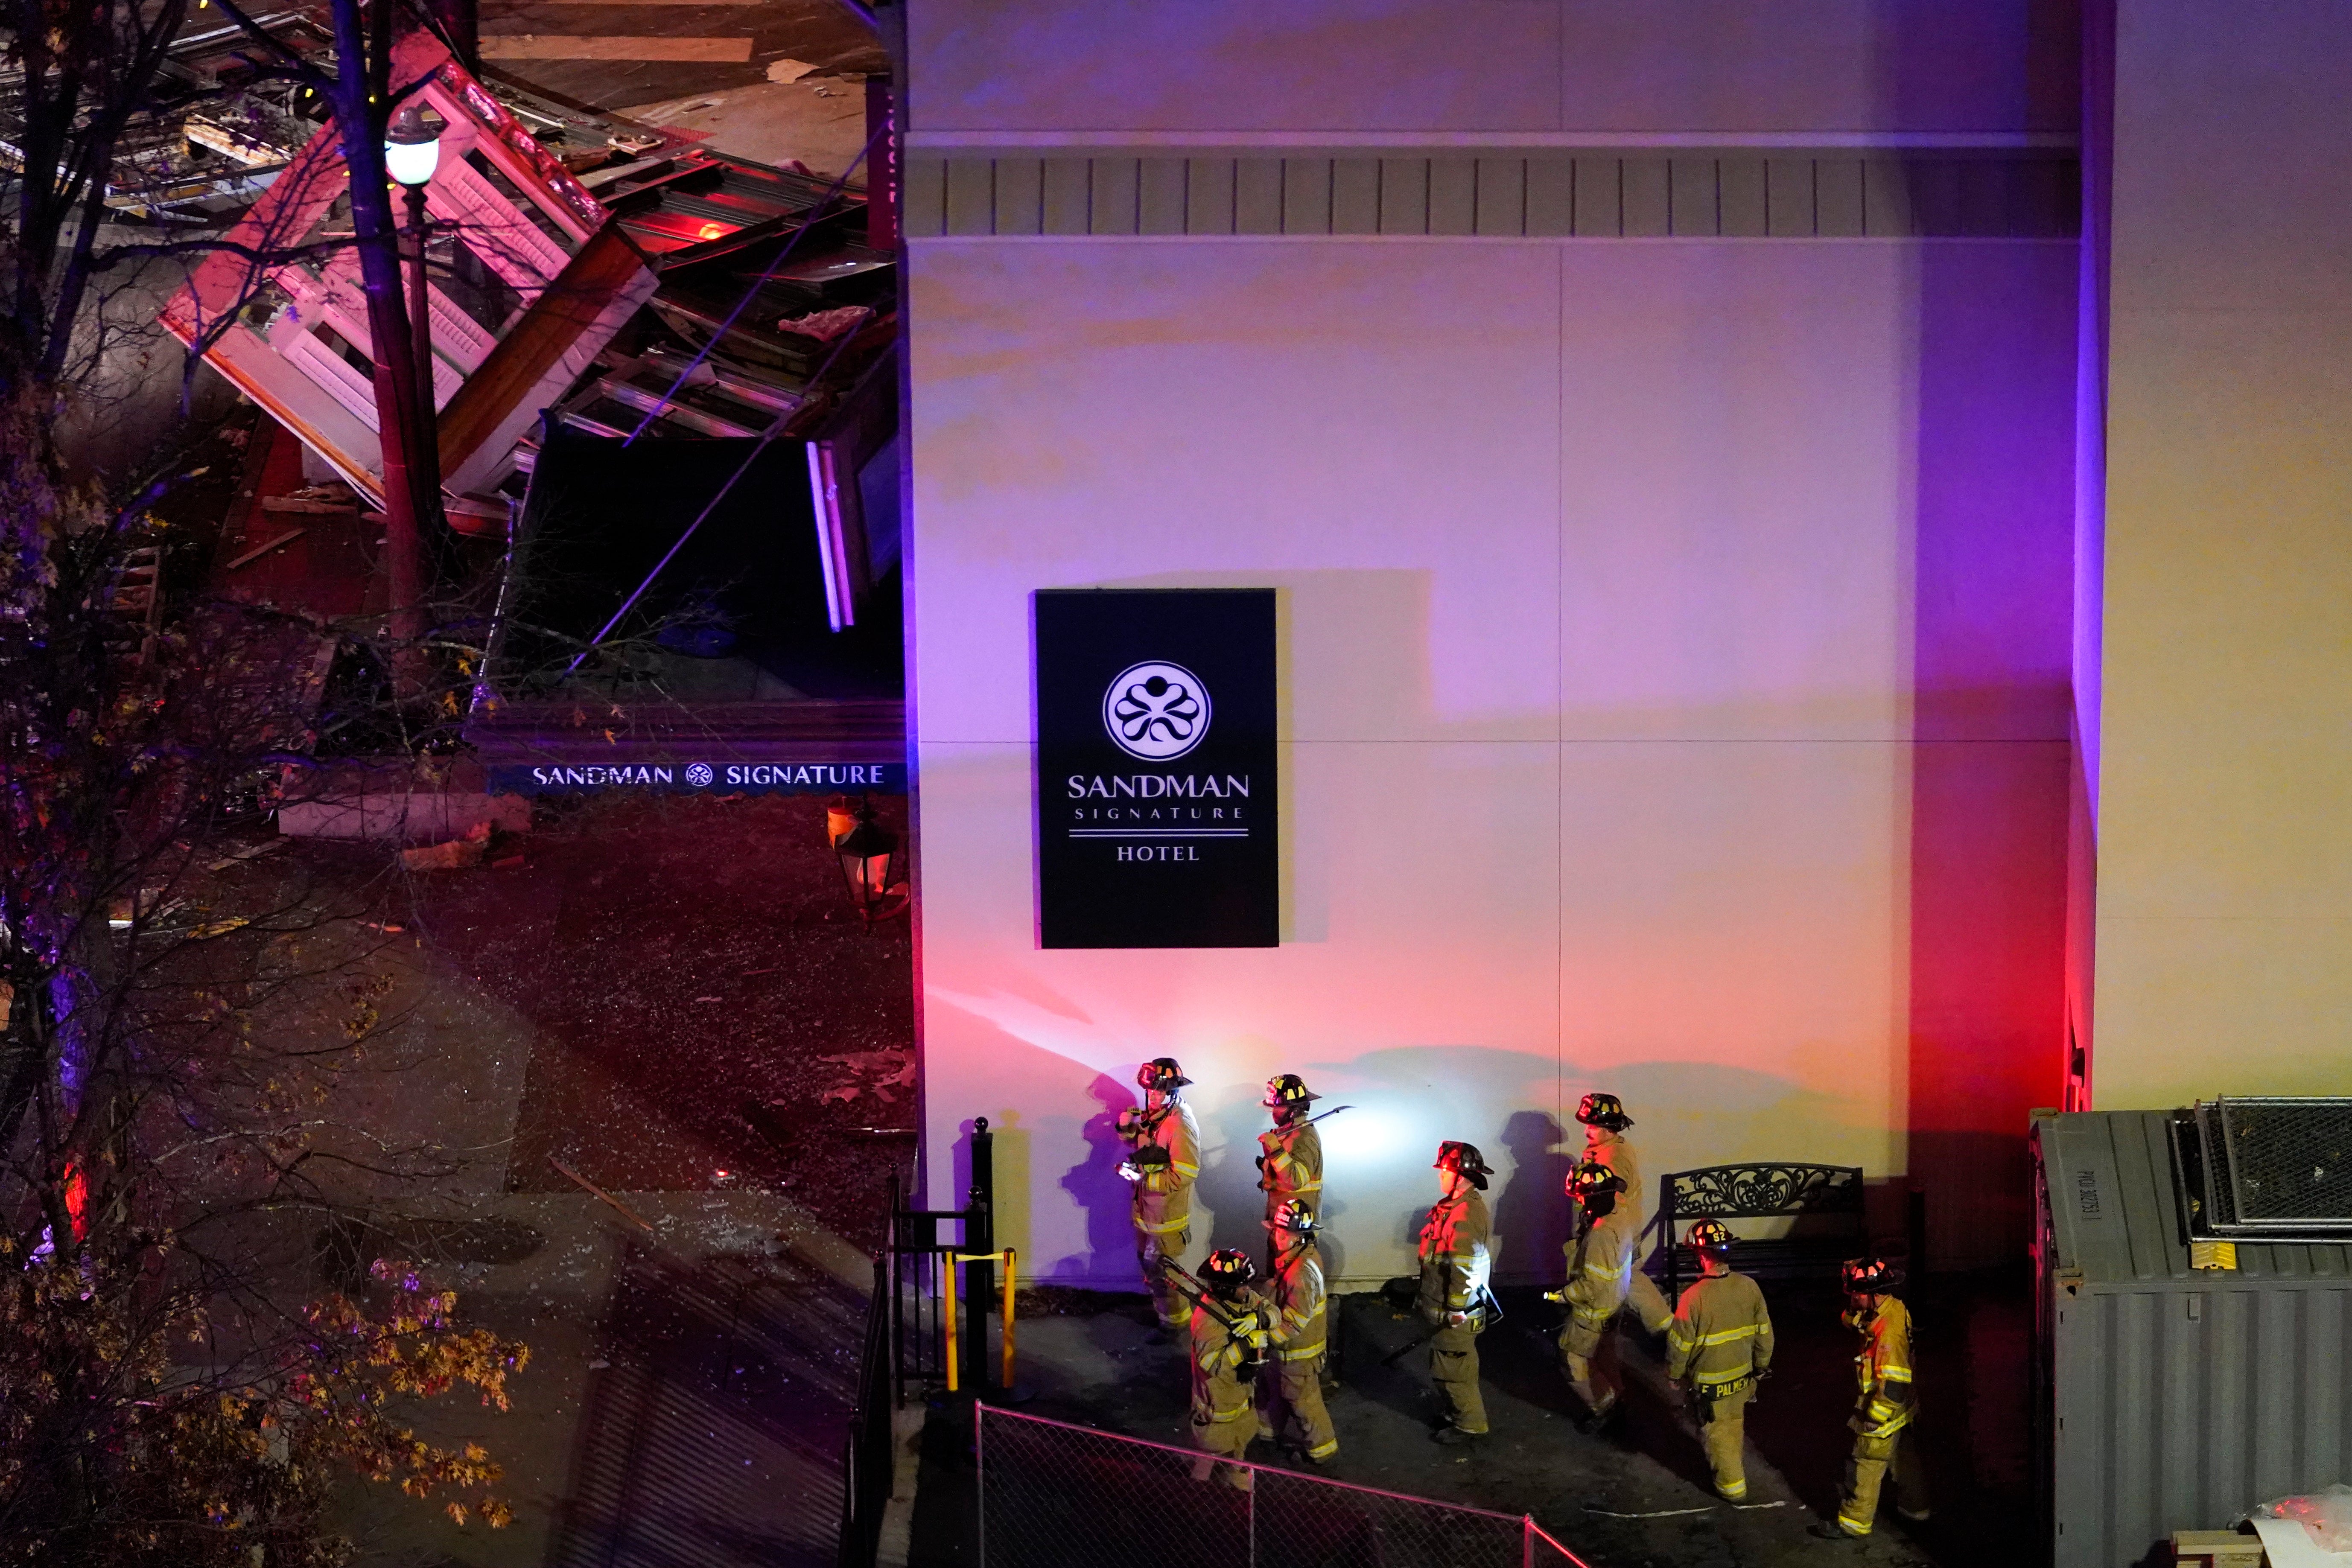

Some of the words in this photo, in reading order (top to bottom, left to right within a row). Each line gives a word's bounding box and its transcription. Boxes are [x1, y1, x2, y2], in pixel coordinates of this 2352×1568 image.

[533, 766, 673, 785] SANDMAN
[727, 765, 884, 784] SIGNATURE
[1068, 774, 1249, 799] SANDMAN
[1075, 807, 1242, 819] SIGNATURE
[1117, 846, 1200, 861] HOTEL
